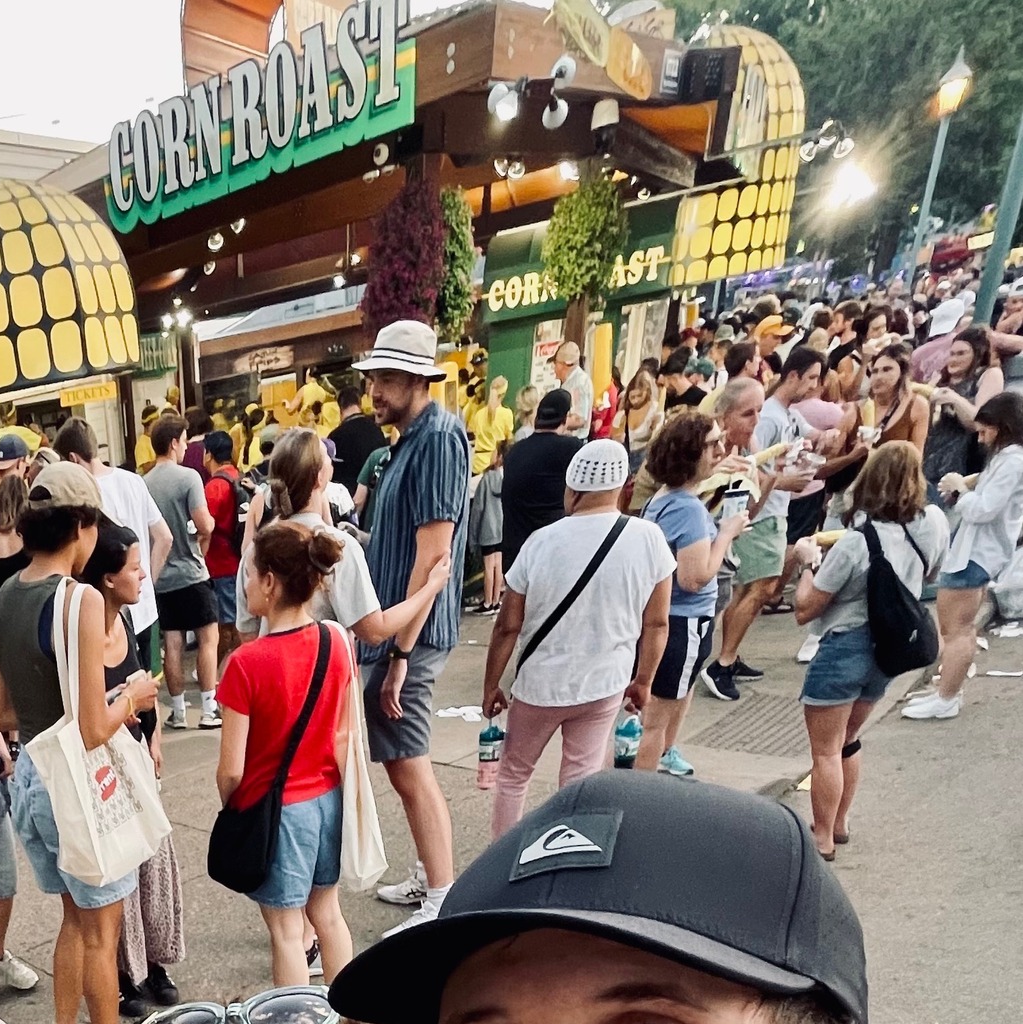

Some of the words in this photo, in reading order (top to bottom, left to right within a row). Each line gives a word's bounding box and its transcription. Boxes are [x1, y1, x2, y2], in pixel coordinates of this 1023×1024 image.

[108, 72, 223, 212] CORN
[228, 0, 410, 166] ROAST
[608, 245, 665, 288] AST
[65, 385, 111, 403] TICKETS
